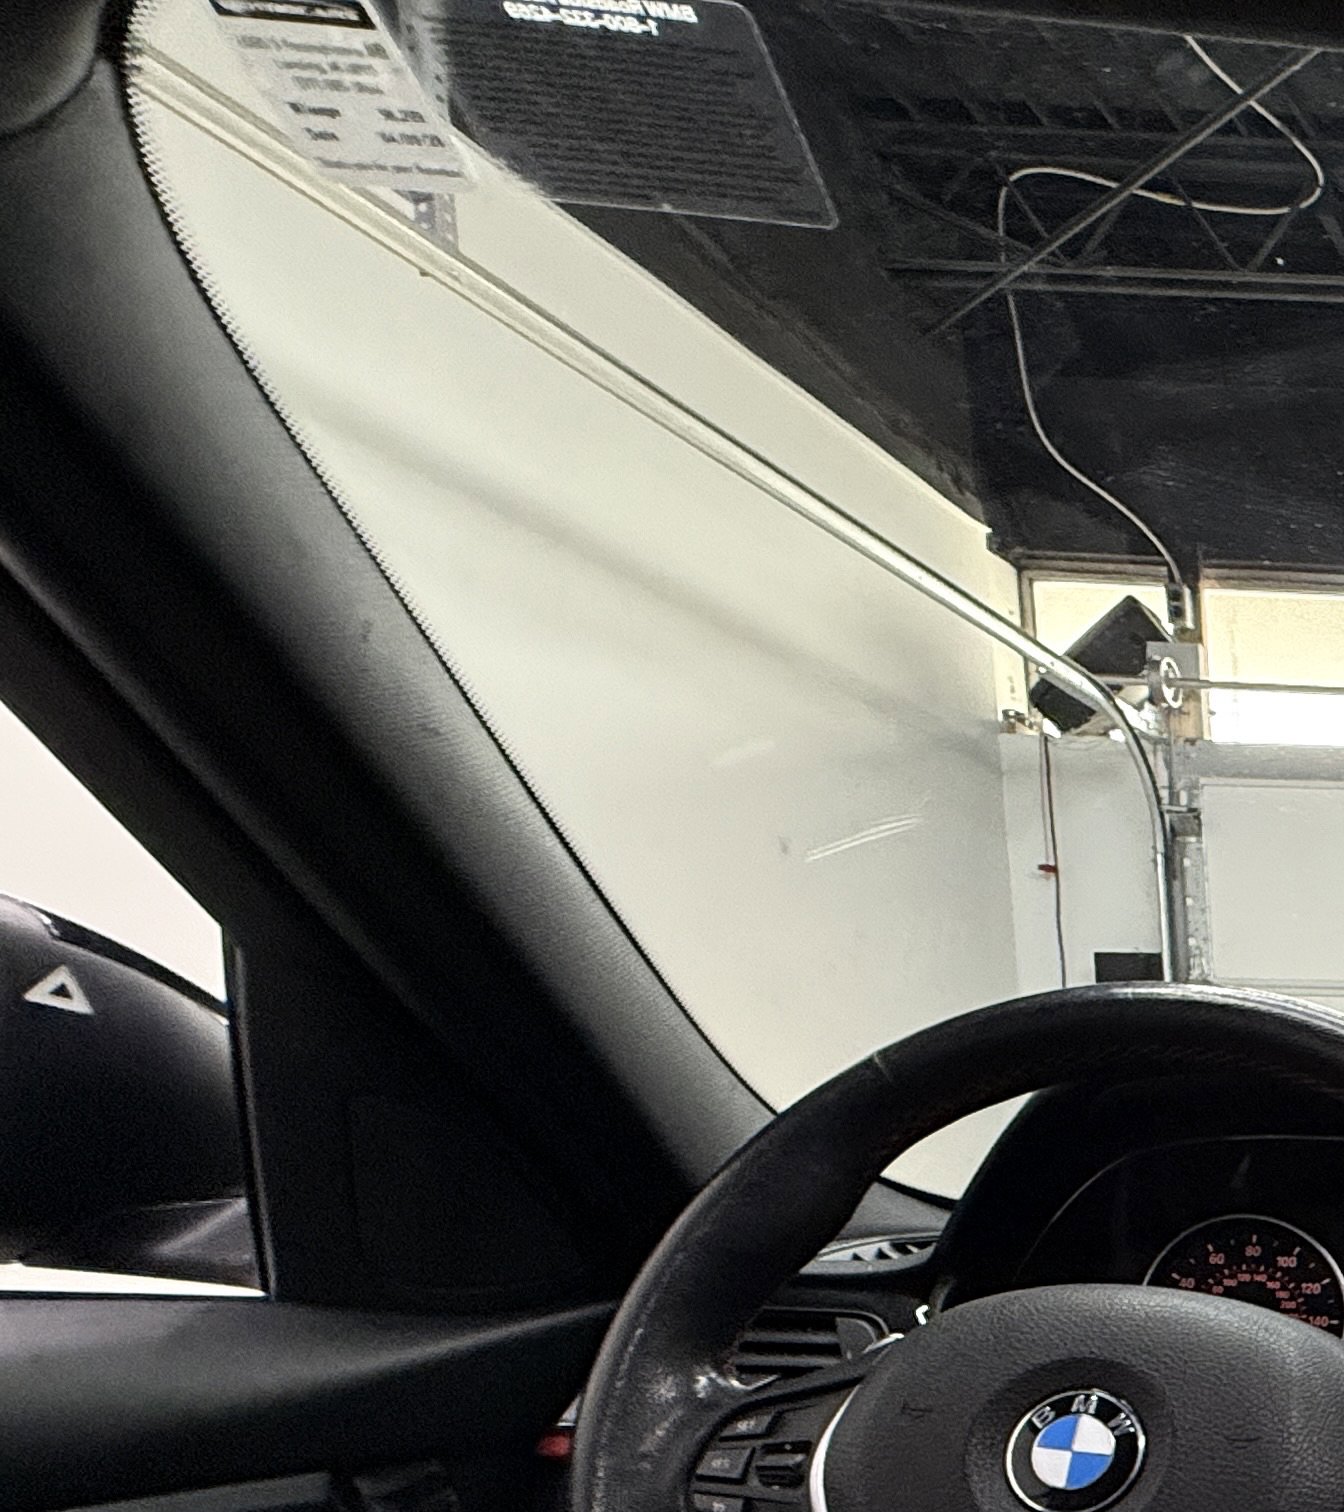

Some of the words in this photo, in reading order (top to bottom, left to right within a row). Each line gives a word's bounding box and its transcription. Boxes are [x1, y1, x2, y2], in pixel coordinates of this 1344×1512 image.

[1208, 1252, 1225, 1265] 60
[1275, 1256, 1297, 1268] 100
[1178, 1277, 1196, 1289] 40
[1301, 1282, 1322, 1295] 120
[1308, 1315, 1330, 1327] 140
[1030, 1393, 1136, 1437] BMW
